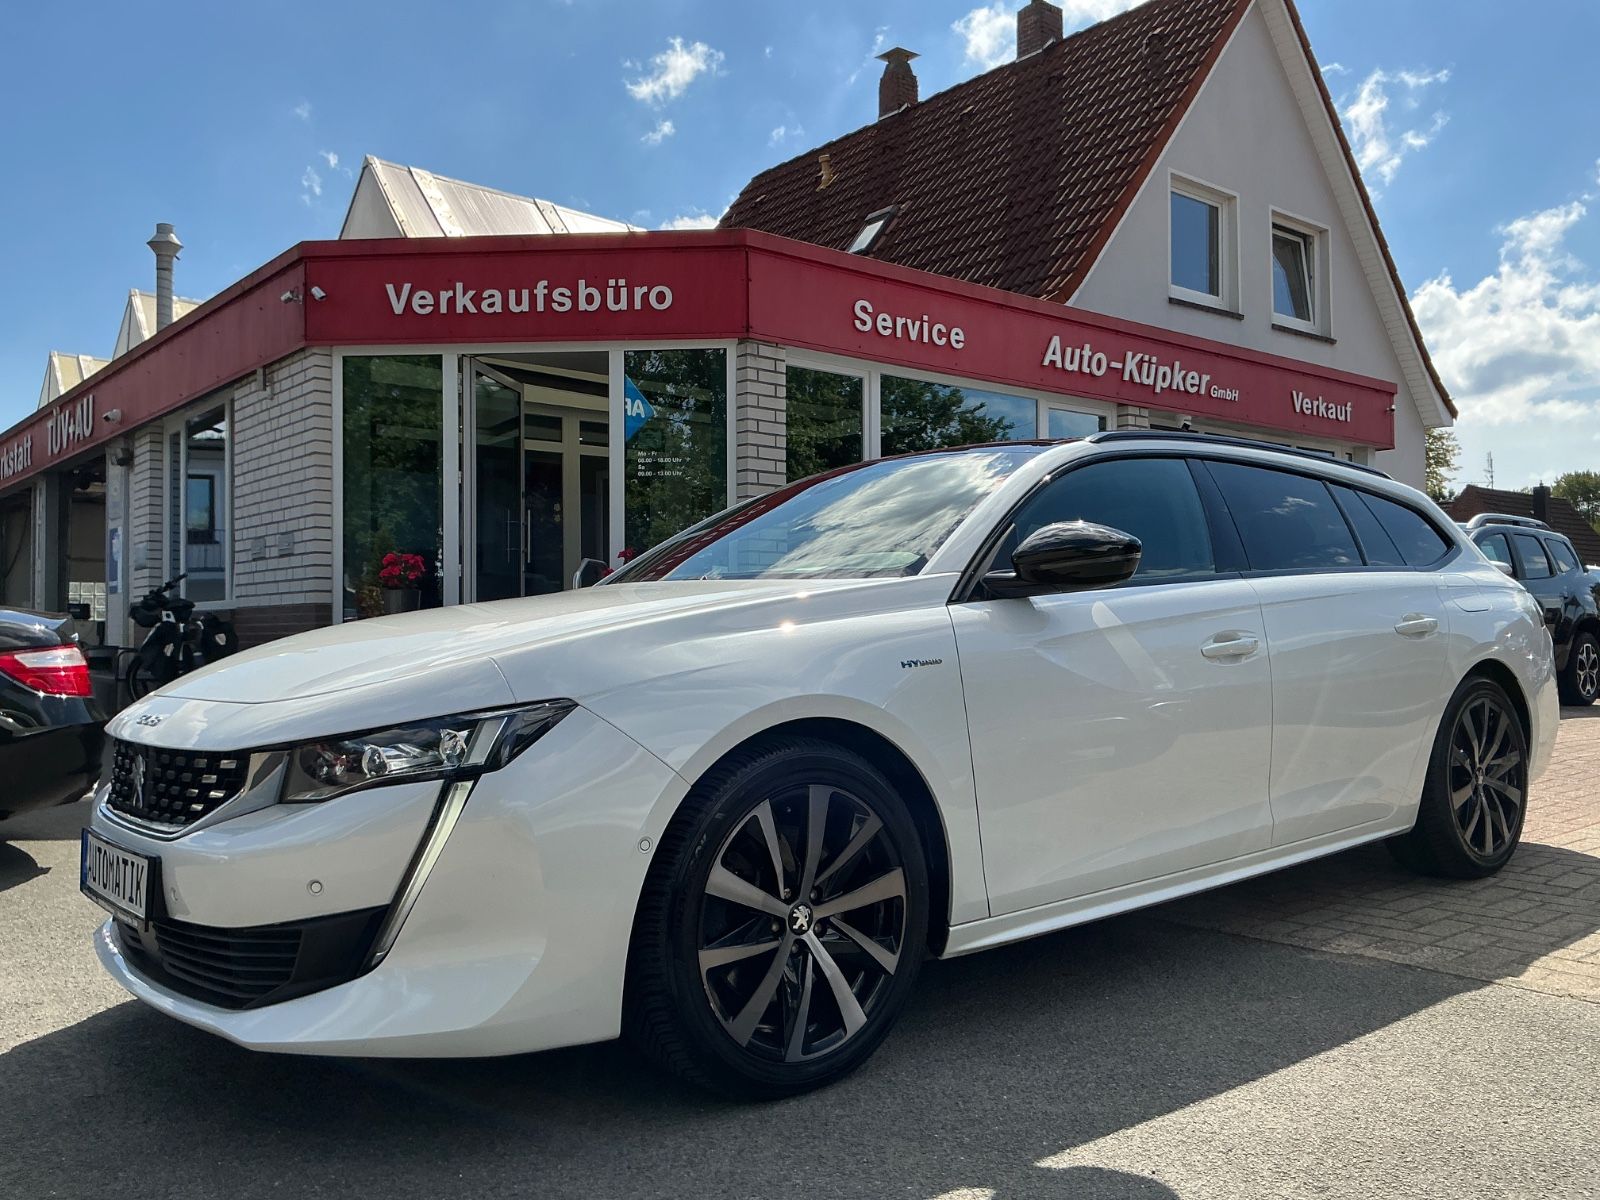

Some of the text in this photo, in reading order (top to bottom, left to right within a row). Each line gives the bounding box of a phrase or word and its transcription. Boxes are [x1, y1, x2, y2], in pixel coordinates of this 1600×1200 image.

[385, 278, 673, 315] Verkaufsbüro
[853, 299, 966, 350] Service
[1042, 335, 1239, 402] Auto-Küpker GmbH
[1291, 390, 1352, 422] Verkauf
[86, 841, 145, 908] AUTOMATIK
